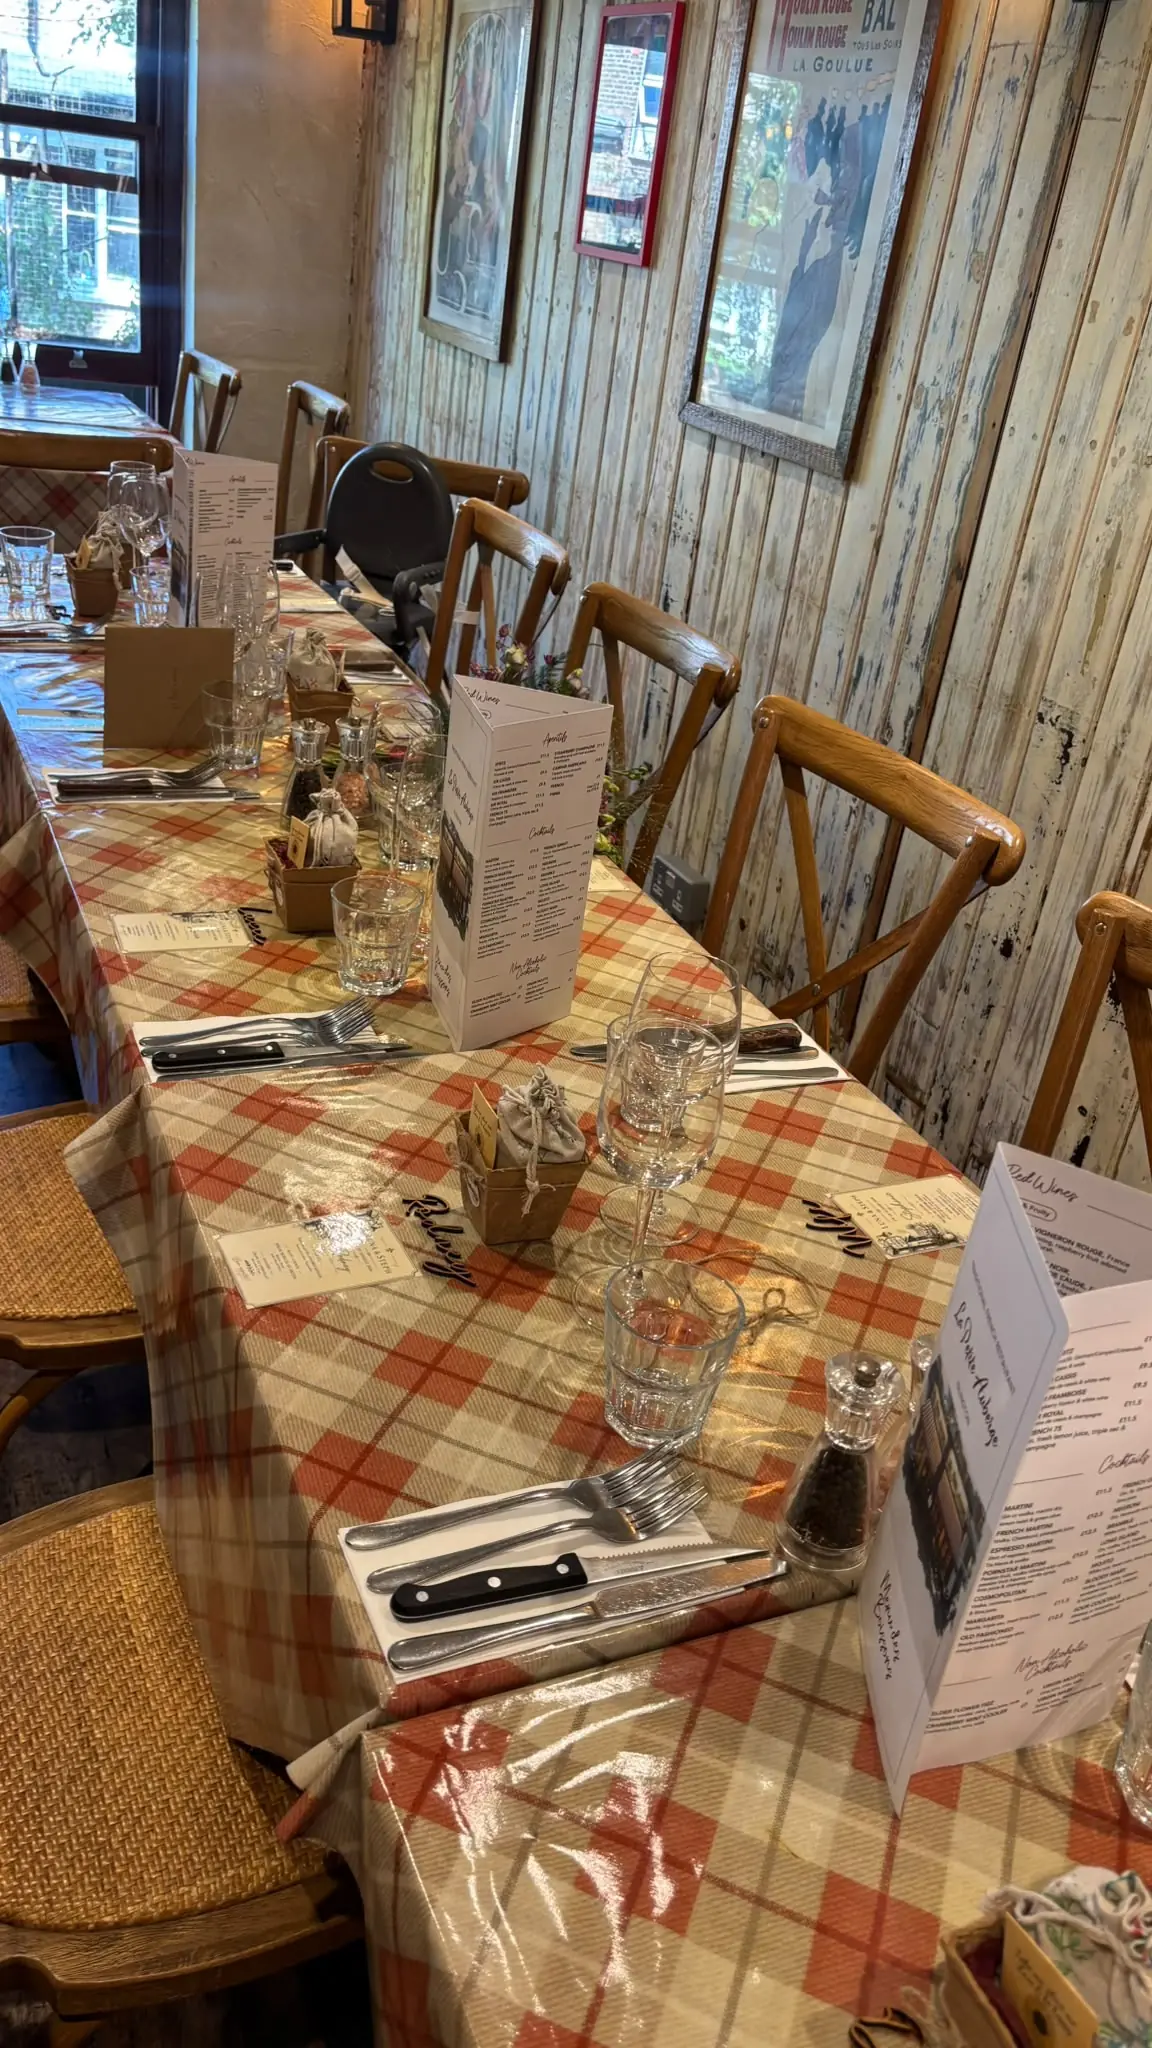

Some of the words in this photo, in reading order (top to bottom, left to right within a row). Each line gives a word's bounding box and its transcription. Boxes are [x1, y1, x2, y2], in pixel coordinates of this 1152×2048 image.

[861, 0, 895, 33] BAL
[815, 25, 848, 48] ROUGE
[793, 59, 806, 72] LA
[813, 56, 873, 73] GOULUE
[1007, 1163, 1036, 1185] Red
[1033, 1176, 1080, 1203] Wines
[1028, 1204, 1051, 1218] Fruity
[1034, 1226, 1075, 1247] VIGNERON
[1106, 1253, 1131, 1268] France
[972, 1374, 999, 1448] Auberge
[1098, 1448, 1151, 1475] Cocktails
[1004, 1502, 1034, 1512] MARTINI
[996, 1528, 1025, 1536] FRENCH
[1025, 1522, 1054, 1532] MARTINI
[990, 1544, 1025, 1554] ESPRESSO
[1026, 1538, 1054, 1548] MARTINI
[973, 1588, 1028, 1602] COSMOPOLITAN
